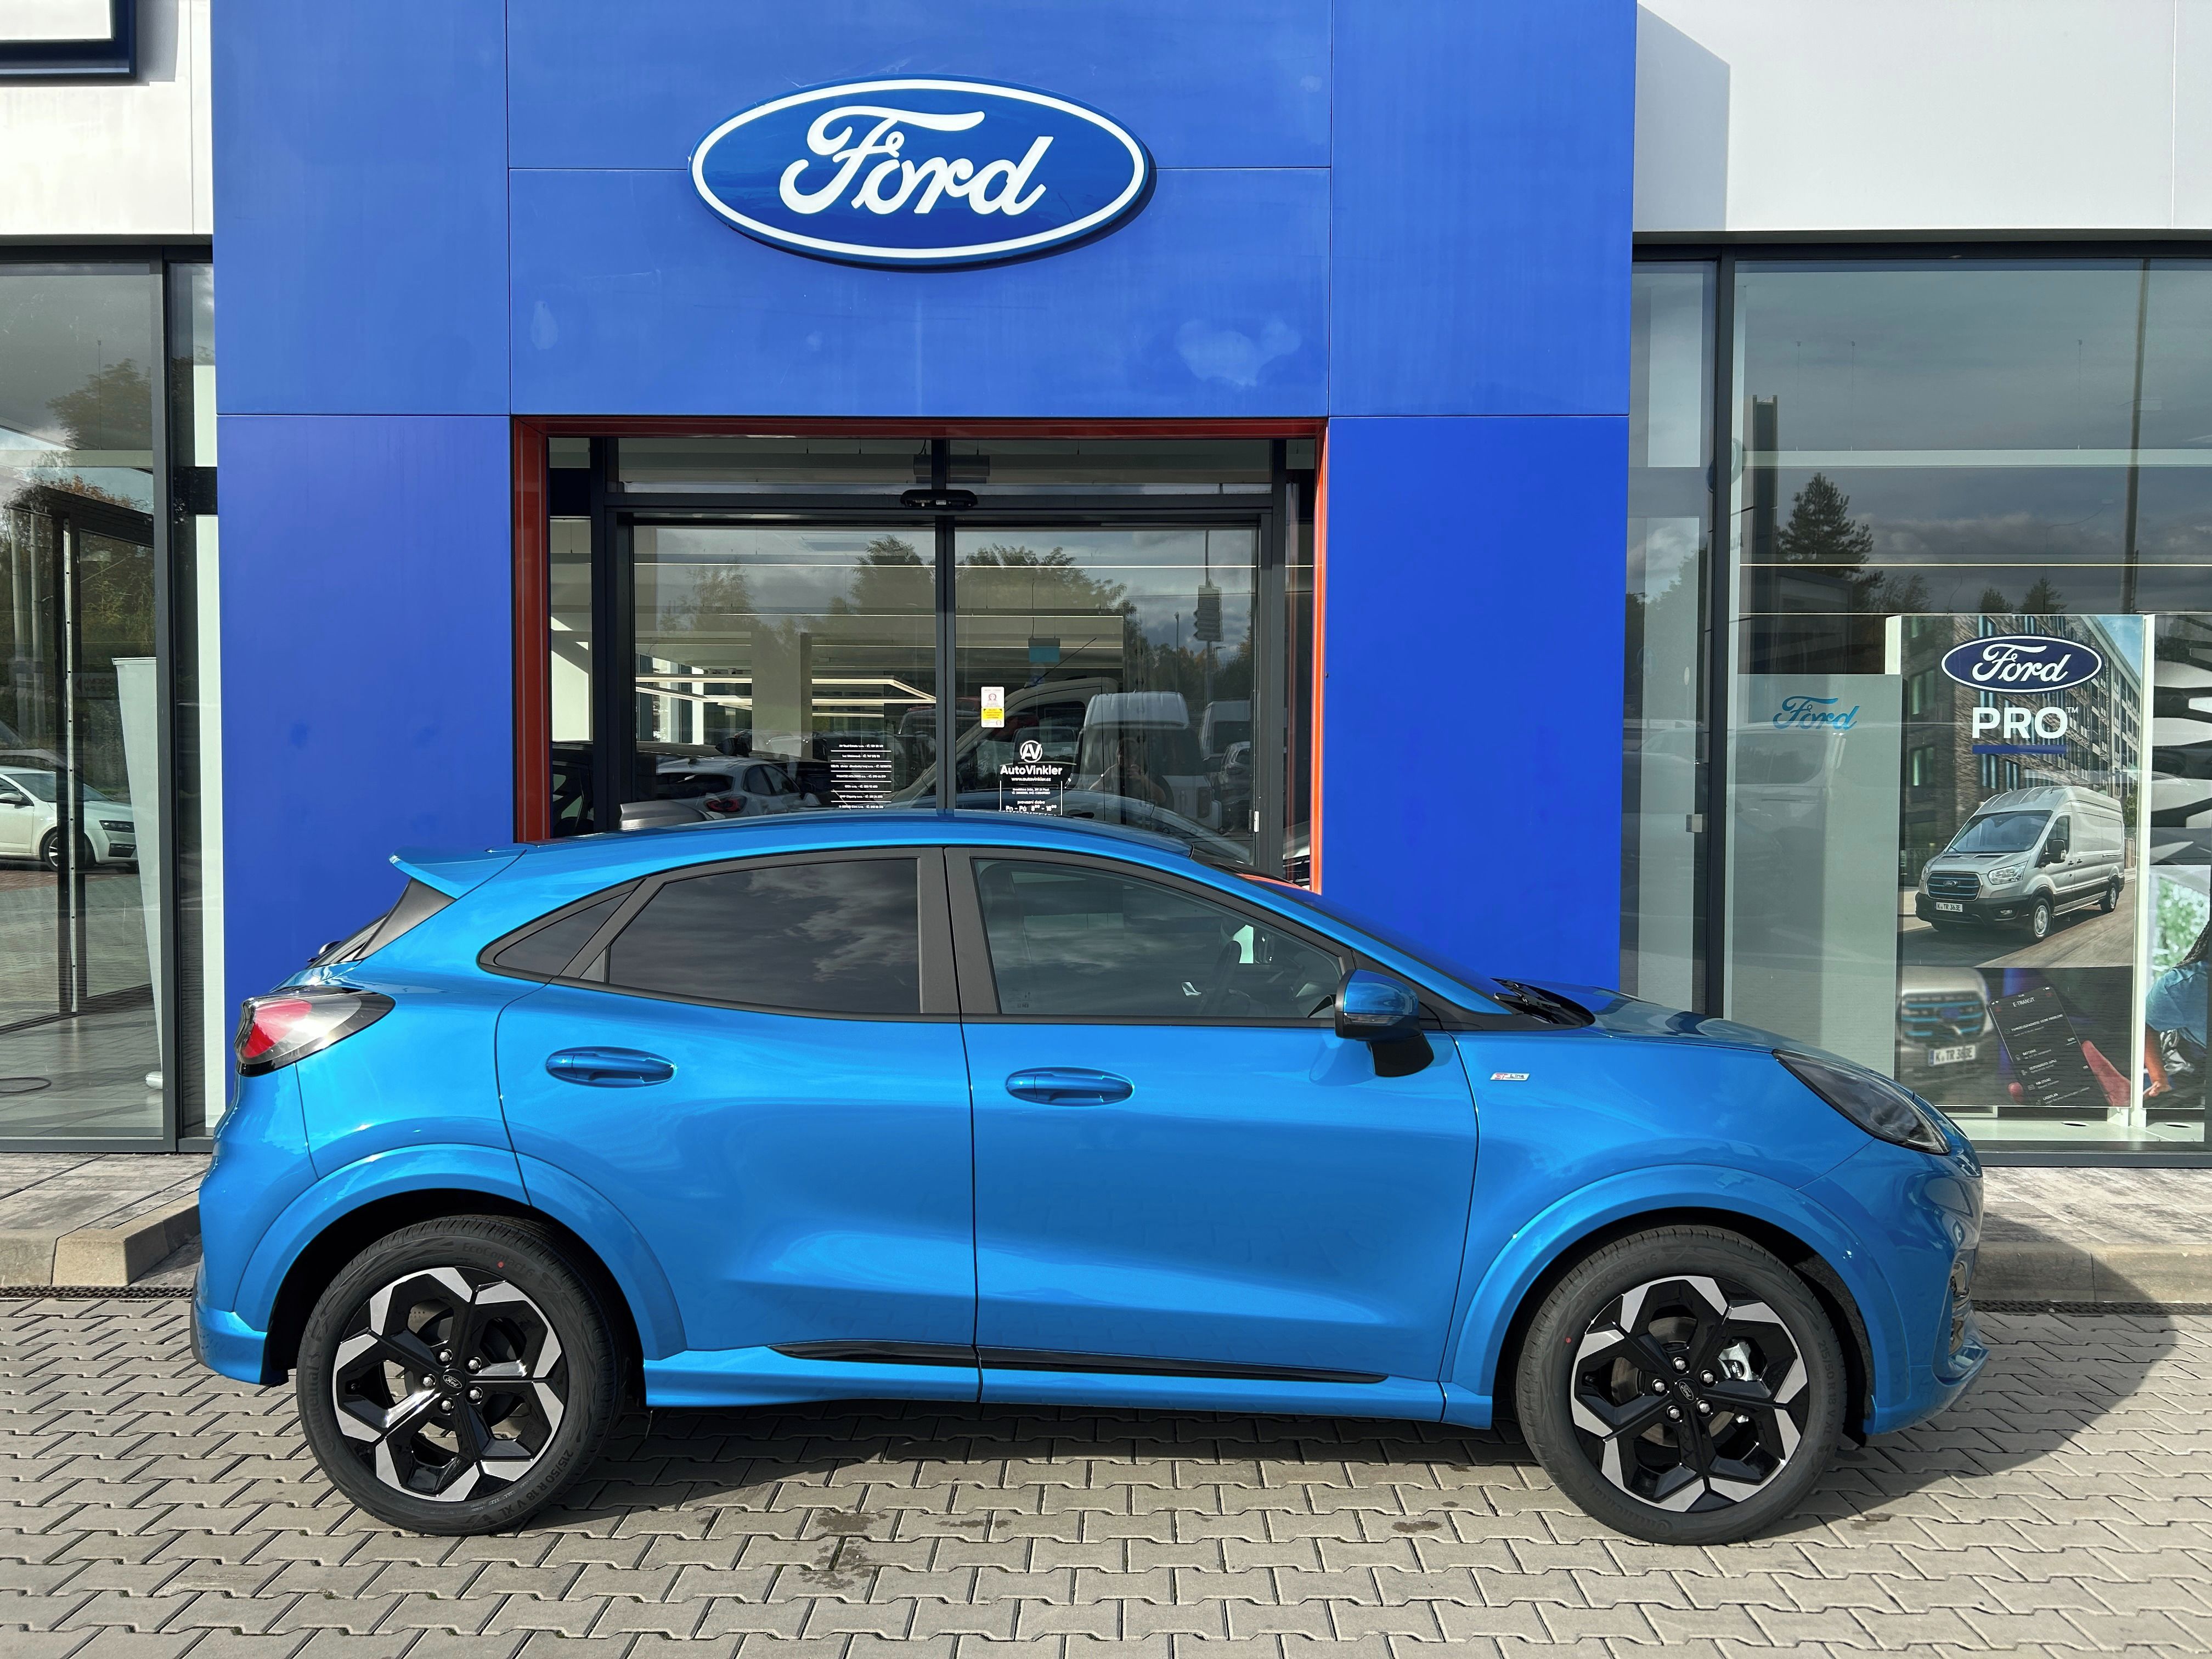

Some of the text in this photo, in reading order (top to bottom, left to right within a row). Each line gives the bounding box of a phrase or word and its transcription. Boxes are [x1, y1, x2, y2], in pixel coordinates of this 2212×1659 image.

[779, 105, 1054, 215] Ford
[1972, 644, 2071, 682] Ford
[1773, 696, 1860, 730] Ford
[1972, 707, 2068, 738] PRO
[1021, 743, 1042, 760] AV
[1000, 765, 1063, 775] AutoVinkler
[2012, 997, 2035, 1007] E-TRANSIT
[545, 1449, 574, 1483] 215/50
[537, 1482, 548, 1492] R
